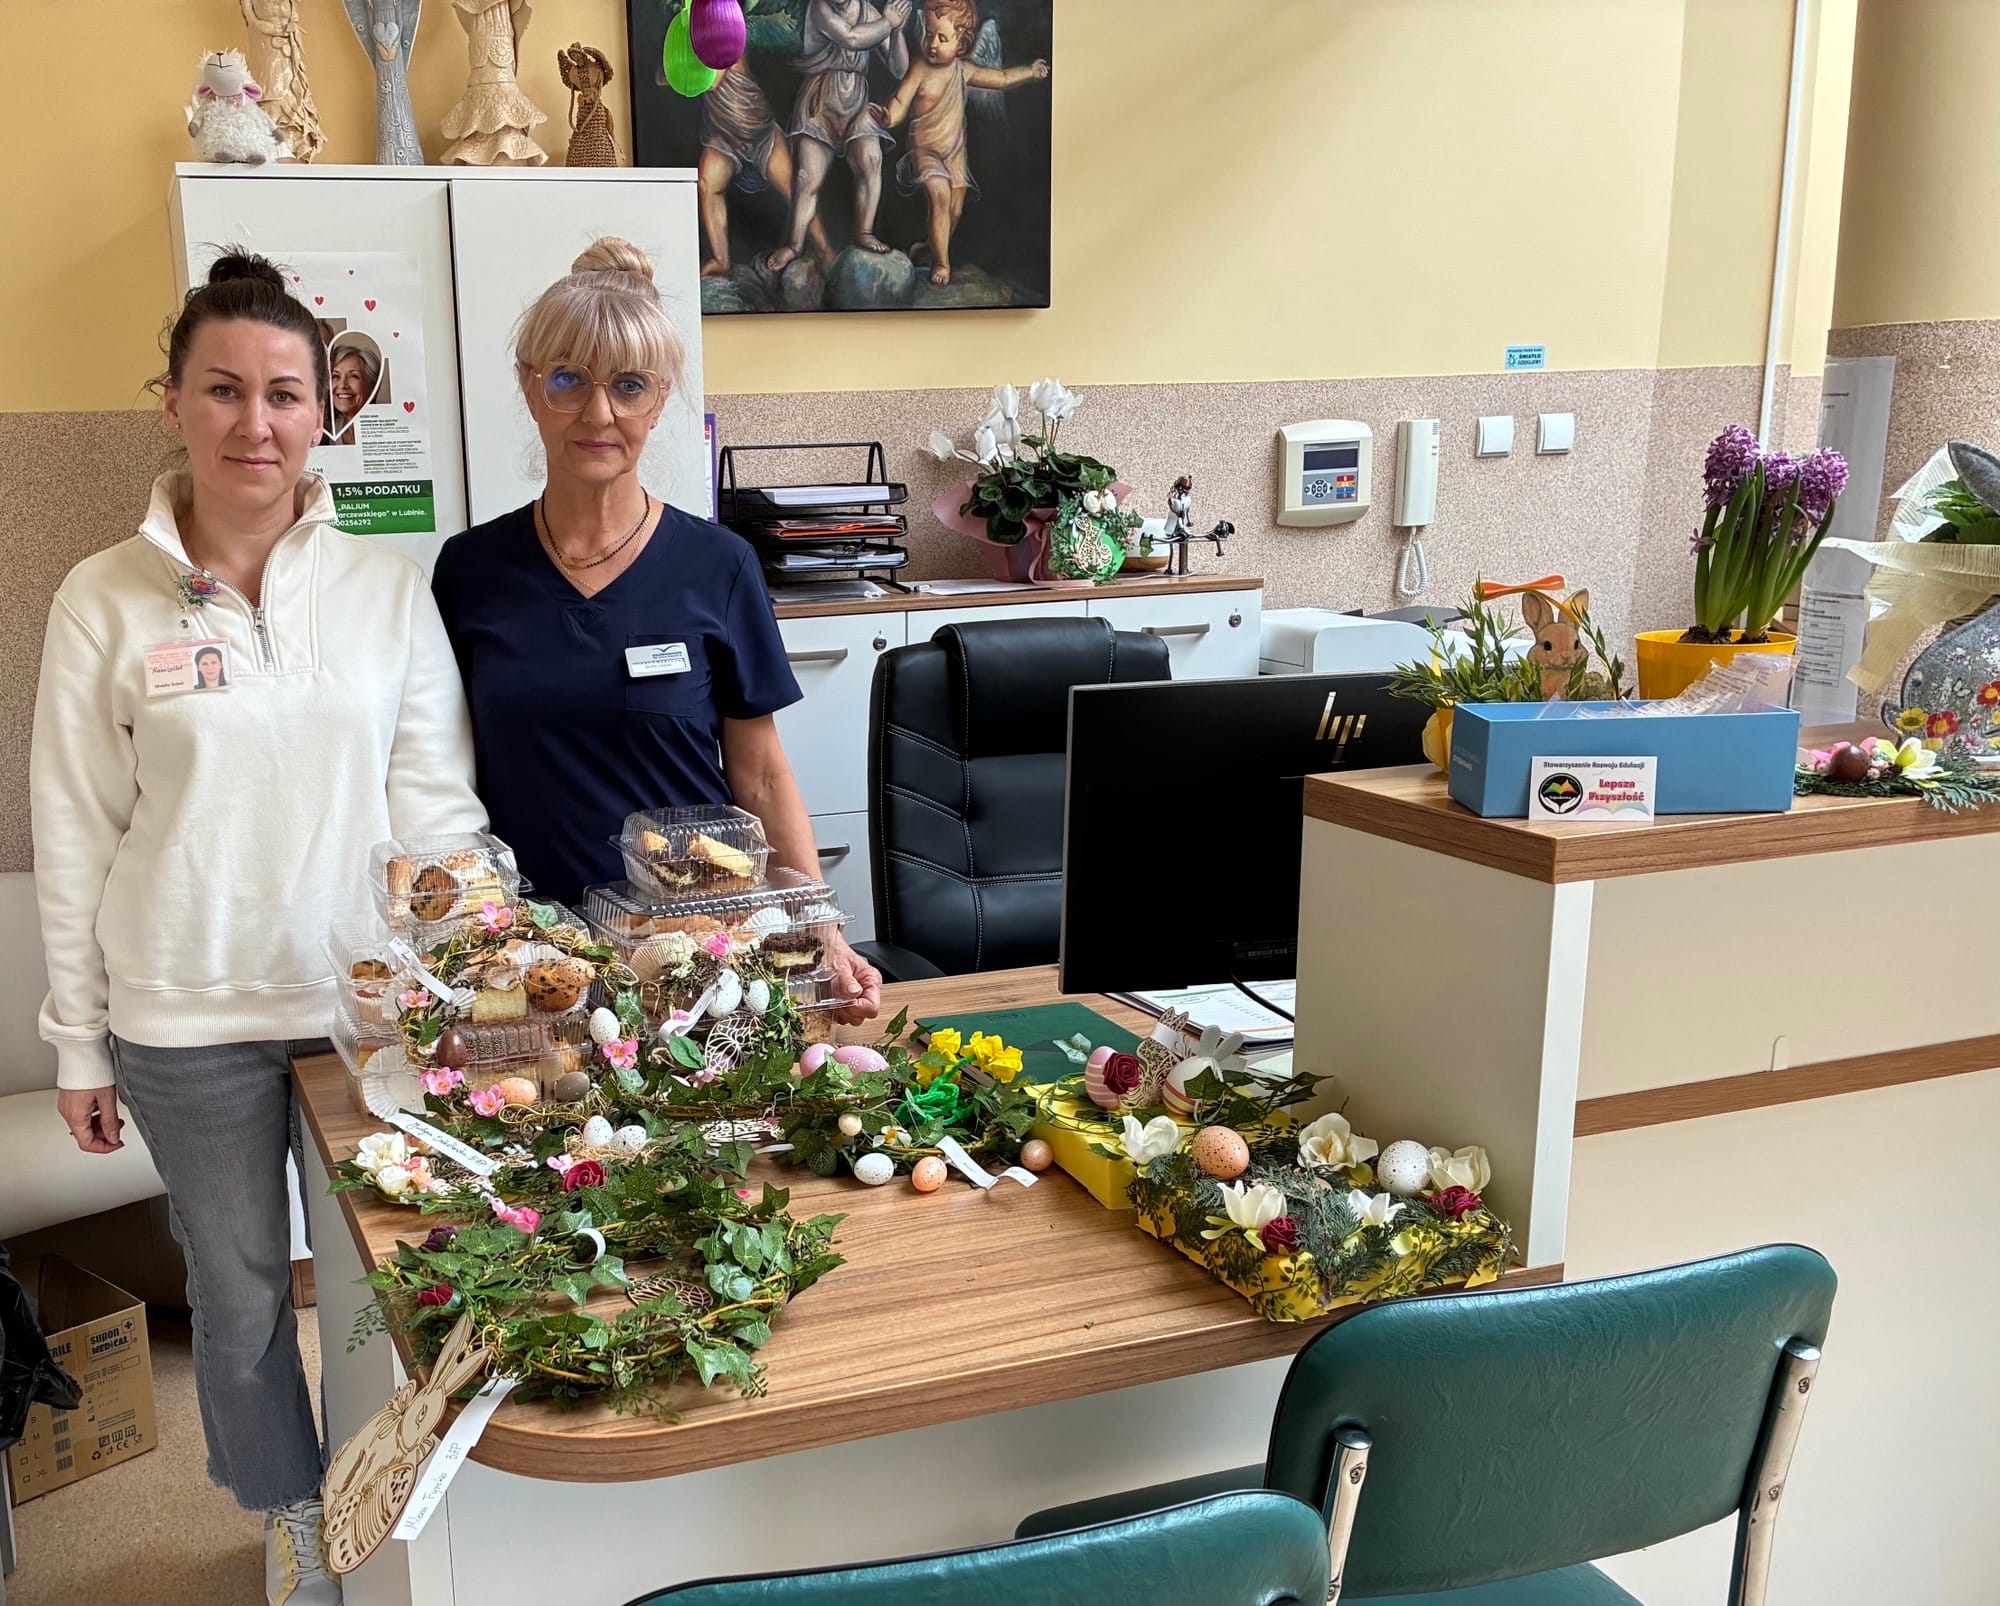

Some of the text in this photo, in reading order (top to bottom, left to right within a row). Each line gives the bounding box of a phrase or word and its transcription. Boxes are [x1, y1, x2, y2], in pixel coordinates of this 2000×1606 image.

[336, 484, 421, 498] 1,5% PODATKU
[1314, 691, 1367, 745] hp
[1543, 761, 1645, 770] Stowarzyszenie Rozwoju Edukacji
[1599, 778, 1636, 791] Lepsza
[1588, 791, 1645, 803] Przyszłość
[32, 1433, 41, 1441] M
